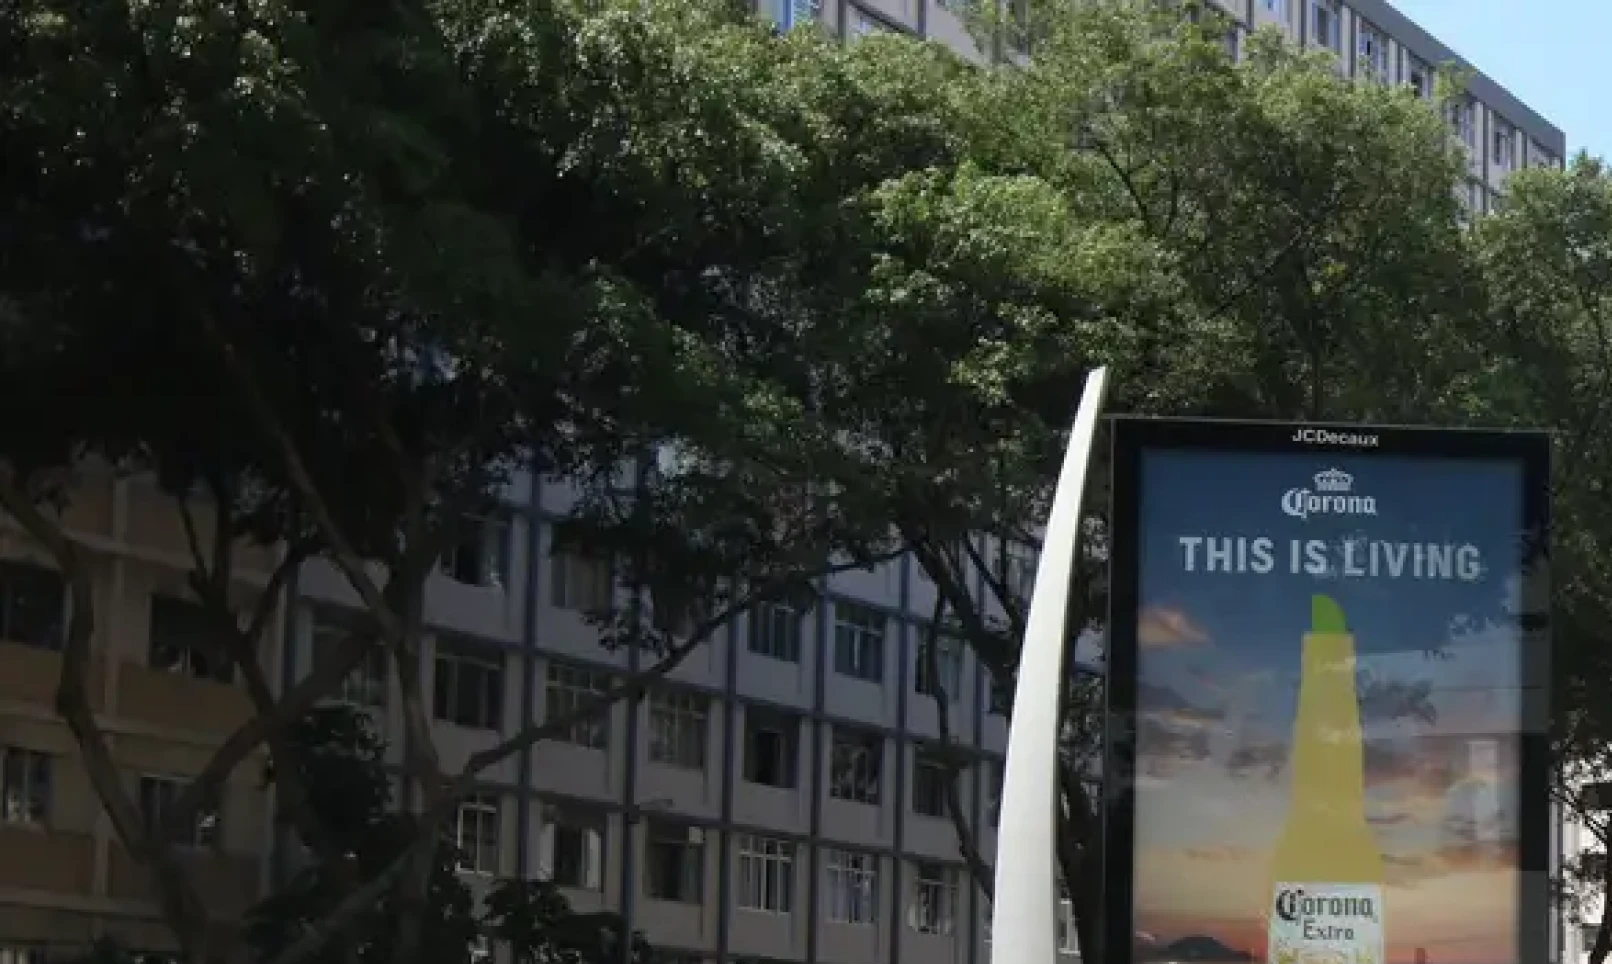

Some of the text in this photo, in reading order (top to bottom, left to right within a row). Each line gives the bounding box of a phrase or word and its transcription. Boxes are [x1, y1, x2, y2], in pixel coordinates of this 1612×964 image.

[1292, 429, 1379, 447] JCDecaux
[1281, 487, 1378, 521] Corona
[1179, 537, 1481, 581] THIS IS LIVING
[1275, 889, 1376, 923] Corona
